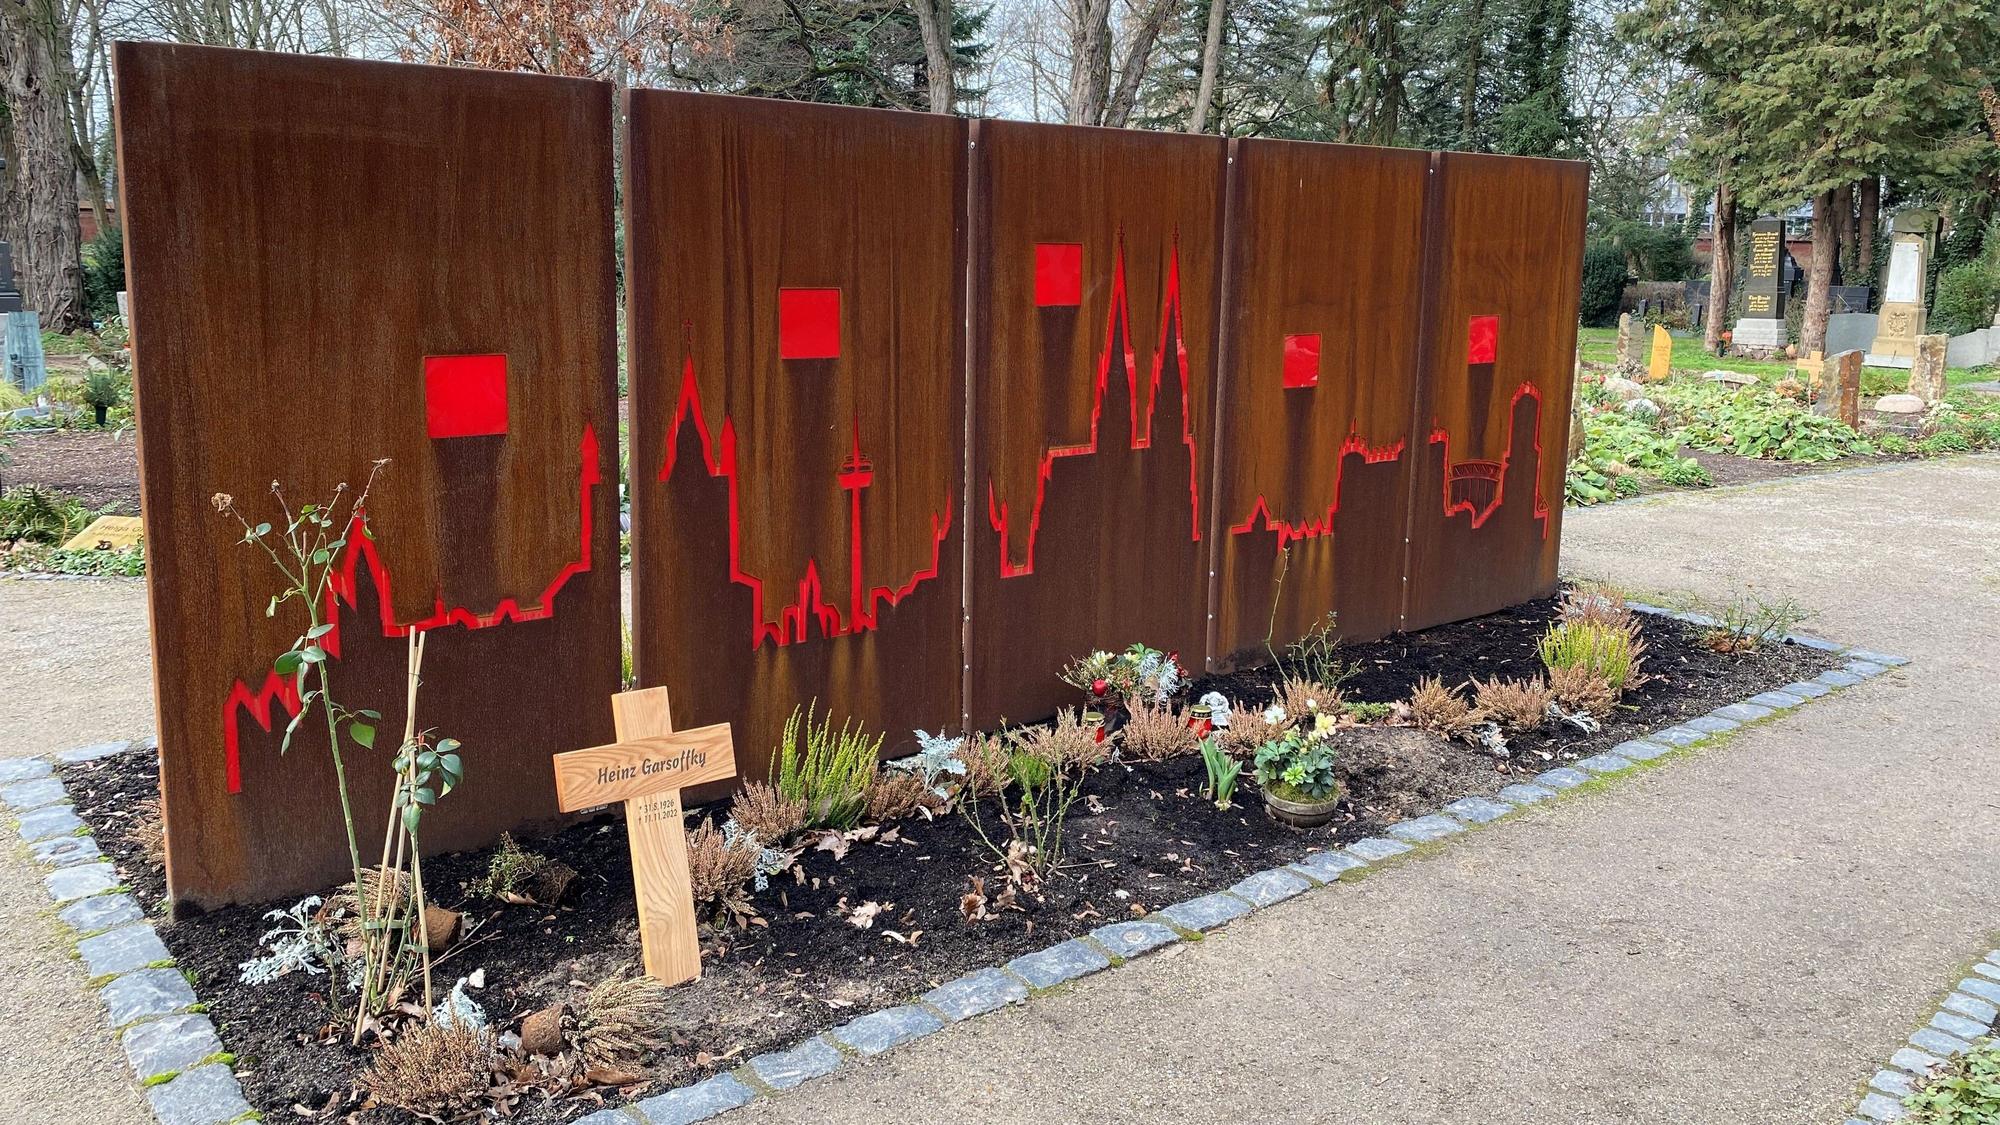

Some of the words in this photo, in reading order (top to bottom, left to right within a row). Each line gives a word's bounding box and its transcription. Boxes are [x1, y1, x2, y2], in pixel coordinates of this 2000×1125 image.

[598, 765, 636, 785] Heinz
[641, 748, 706, 774] Garsoffky
[644, 808, 678, 823] 11.11.2022
